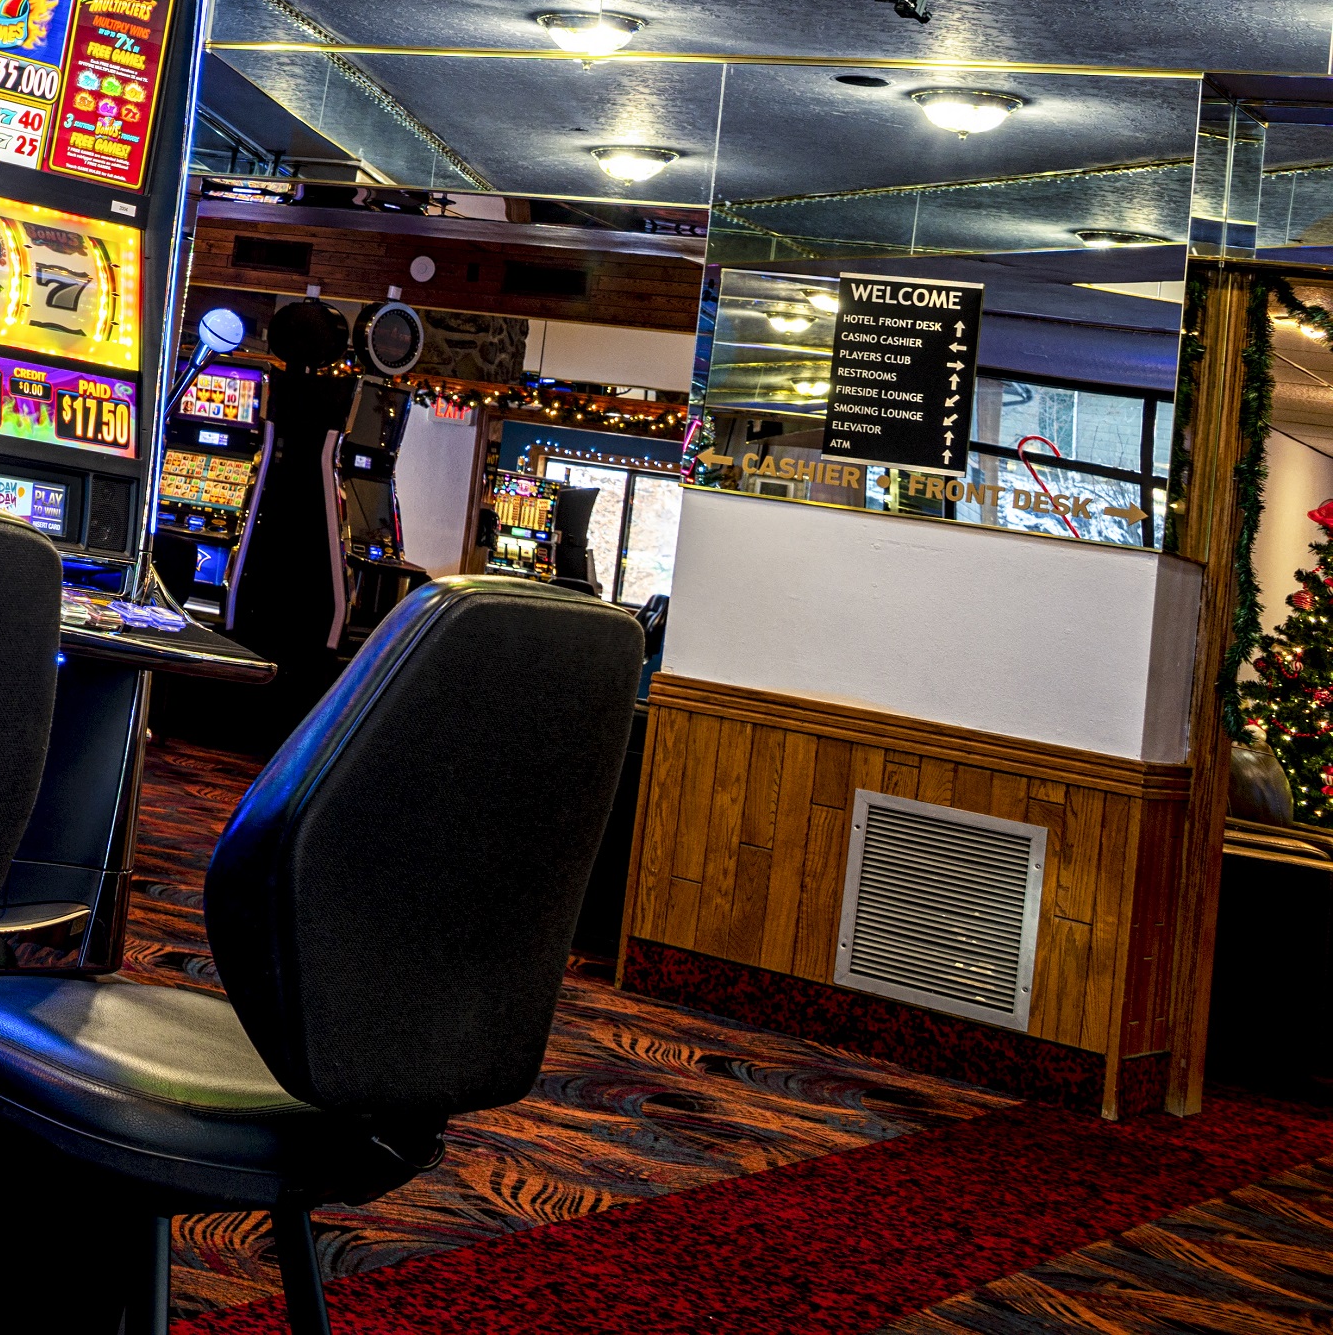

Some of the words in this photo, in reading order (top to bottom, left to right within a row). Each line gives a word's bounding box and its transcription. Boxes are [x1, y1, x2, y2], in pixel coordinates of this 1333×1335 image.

[851, 283, 962, 309] WELCOME
[843, 315, 878, 325] HOTEL
[879, 318, 913, 328] FRONT
[916, 321, 942, 331] DESK
[841, 332, 877, 343] CASINO
[880, 336, 922, 348] CASHIER
[840, 350, 881, 361] PLAYERS
[885, 354, 911, 364] CLUB
[14, 367, 46, 382] CREDIT
[838, 368, 897, 381] RESTROOMS
[78, 380, 112, 400] PAID
[836, 386, 878, 397] FIRESIDE
[882, 391, 923, 402] LOUNGE
[61, 394, 130, 446] $17.50
[834, 403, 878, 415] SMOKING
[881, 408, 923, 421] LOUNGE
[832, 421, 881, 434] ELEVATOR
[830, 439, 850, 448] ATM
[741, 452, 860, 489] CASHIER
[909, 475, 1005, 507] FRONT
[1012, 488, 1093, 520] DESK
